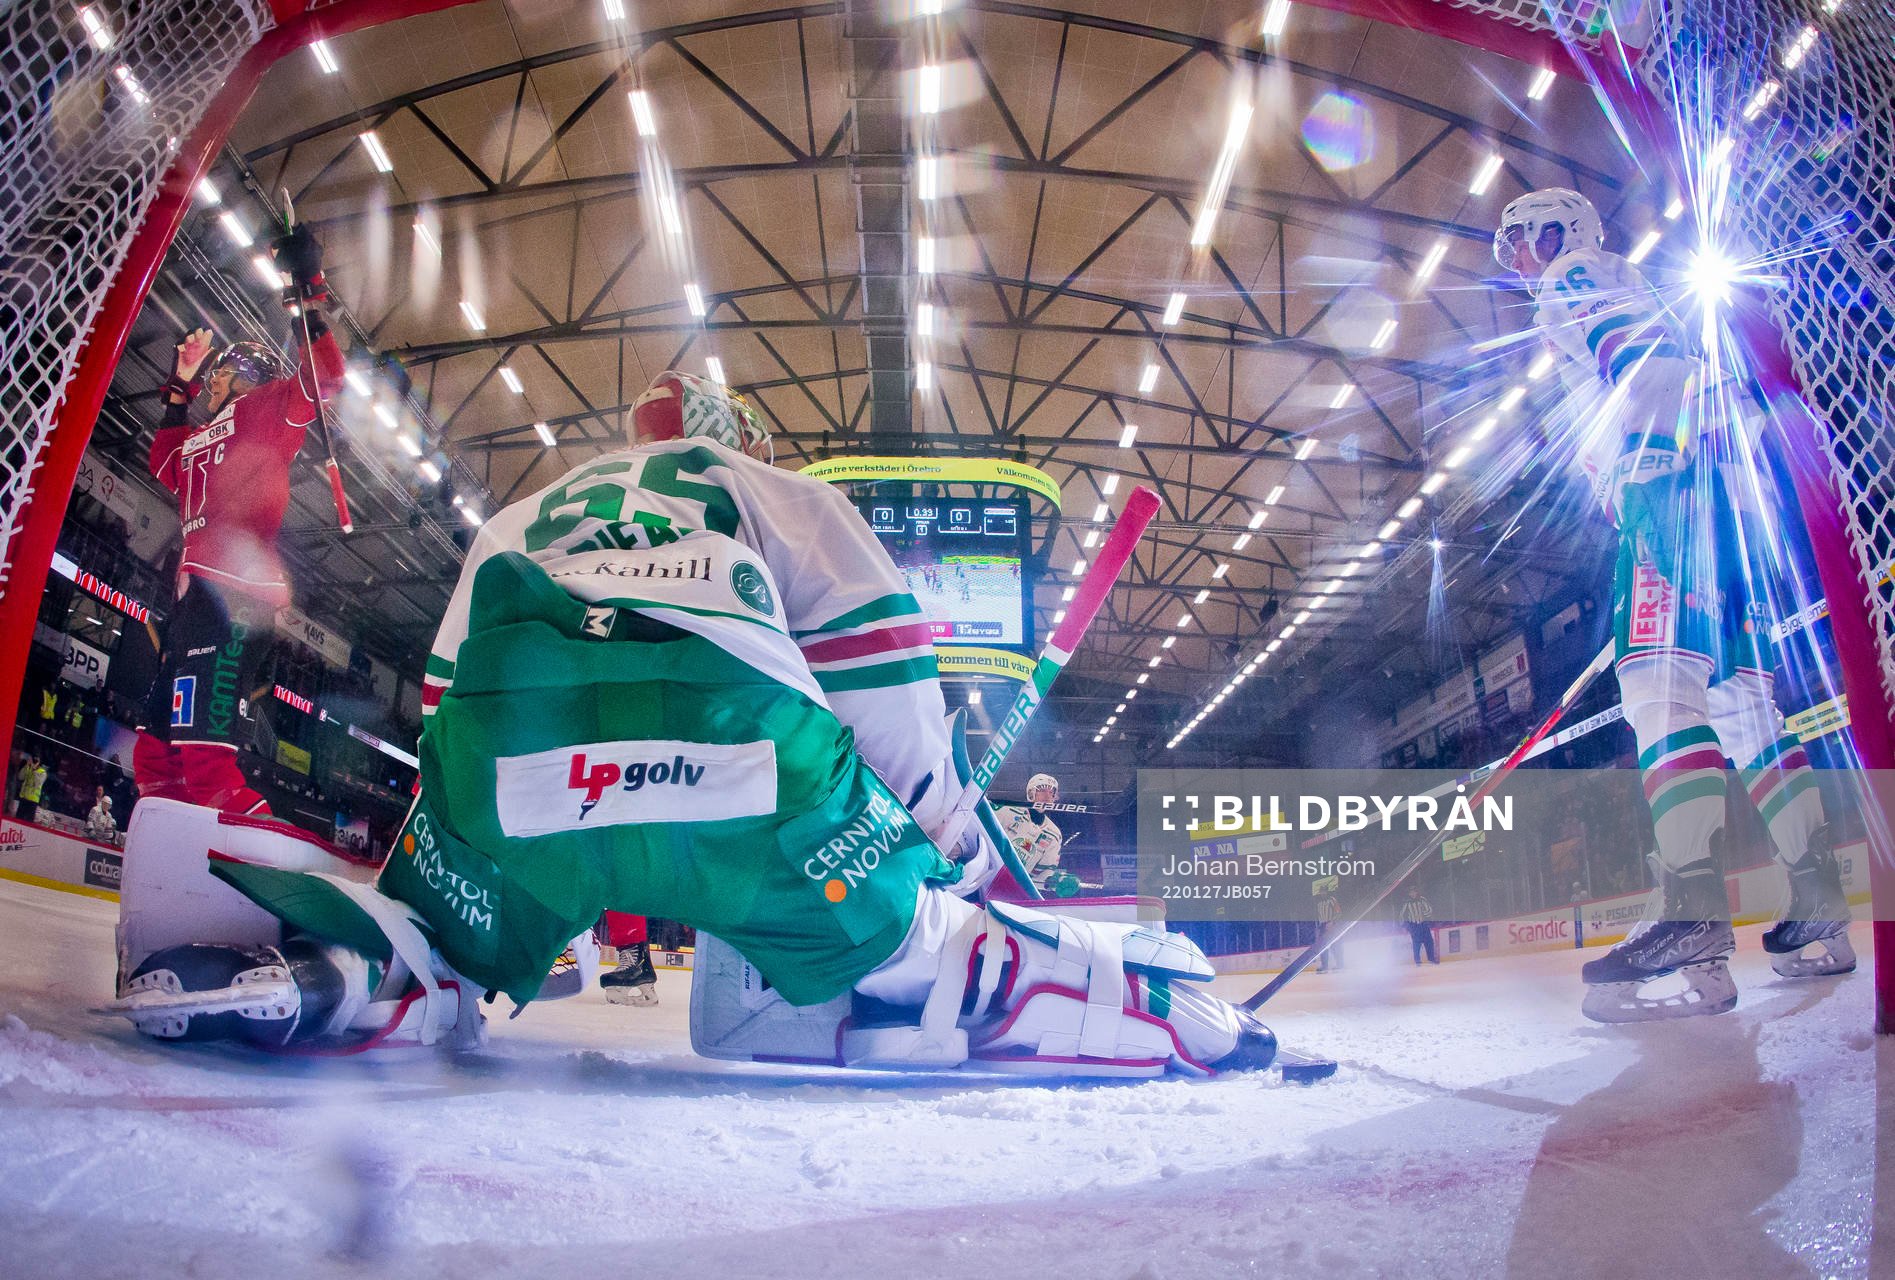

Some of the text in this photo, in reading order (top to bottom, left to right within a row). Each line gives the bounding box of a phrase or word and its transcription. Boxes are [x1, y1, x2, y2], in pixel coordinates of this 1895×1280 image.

[208, 423, 229, 439] OBK
[834, 465, 849, 474] tre
[849, 463, 900, 473] verkstäder
[907, 463, 941, 473] Örebro
[881, 510, 889, 520] 0
[955, 511, 963, 521] 0
[936, 653, 992, 667] kommen
[994, 656, 1009, 669] till
[972, 692, 1037, 791] BAUER
[1032, 801, 1088, 813] BAUER
[804, 785, 892, 881] CERNITOL
[842, 806, 912, 889] NOVUM
[1508, 917, 1569, 945] Scandic
